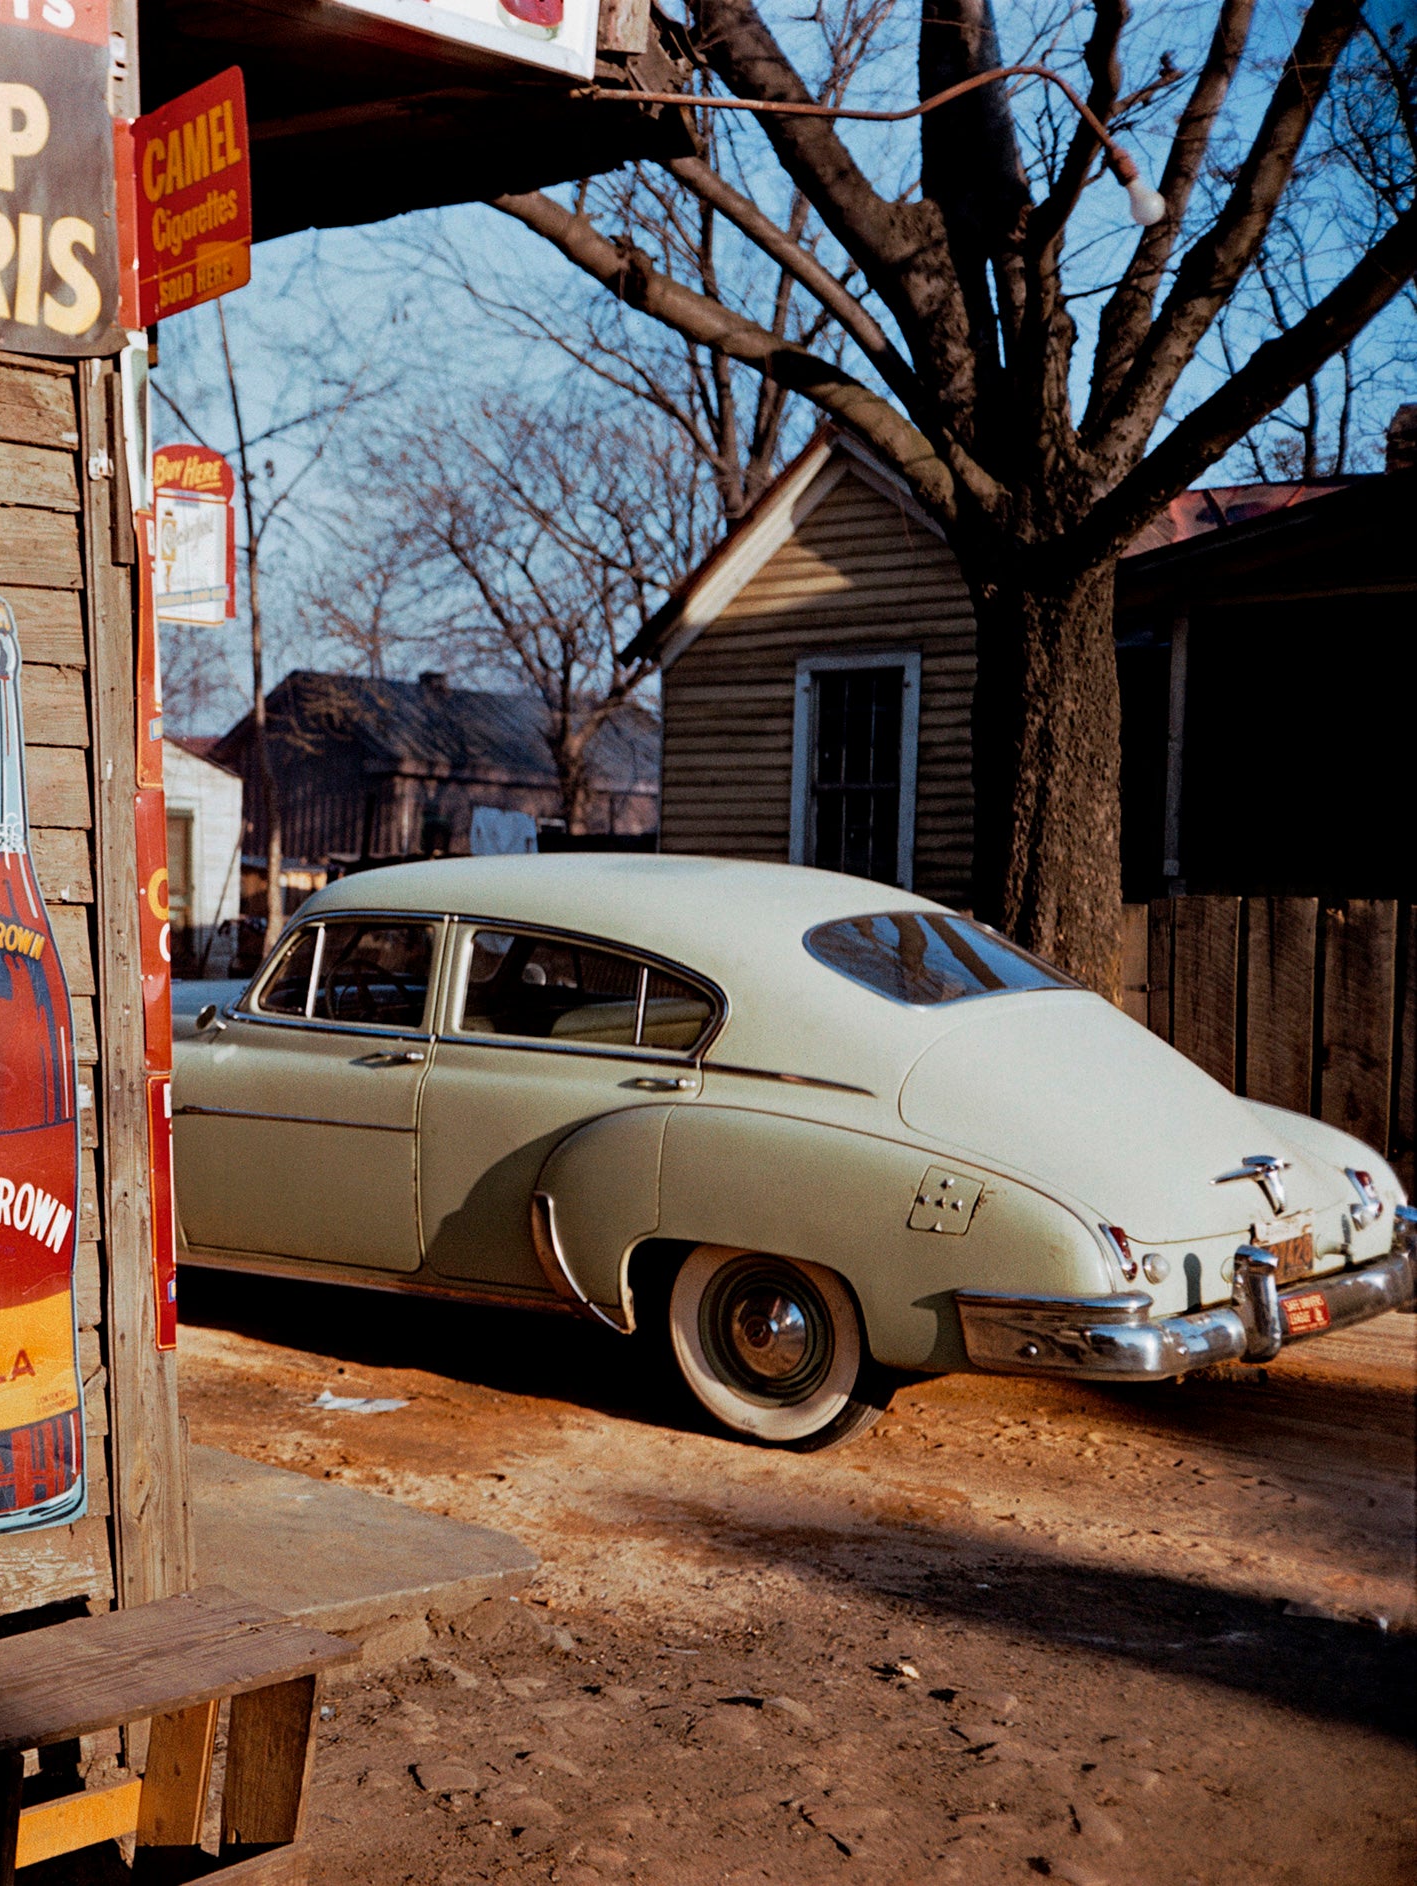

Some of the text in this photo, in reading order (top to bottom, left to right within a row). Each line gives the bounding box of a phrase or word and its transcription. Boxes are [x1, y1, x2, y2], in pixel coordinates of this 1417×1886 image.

[143, 99, 241, 202] CAMEL
[152, 189, 238, 256] Cigarettes
[159, 256, 232, 308] SOLD HERE
